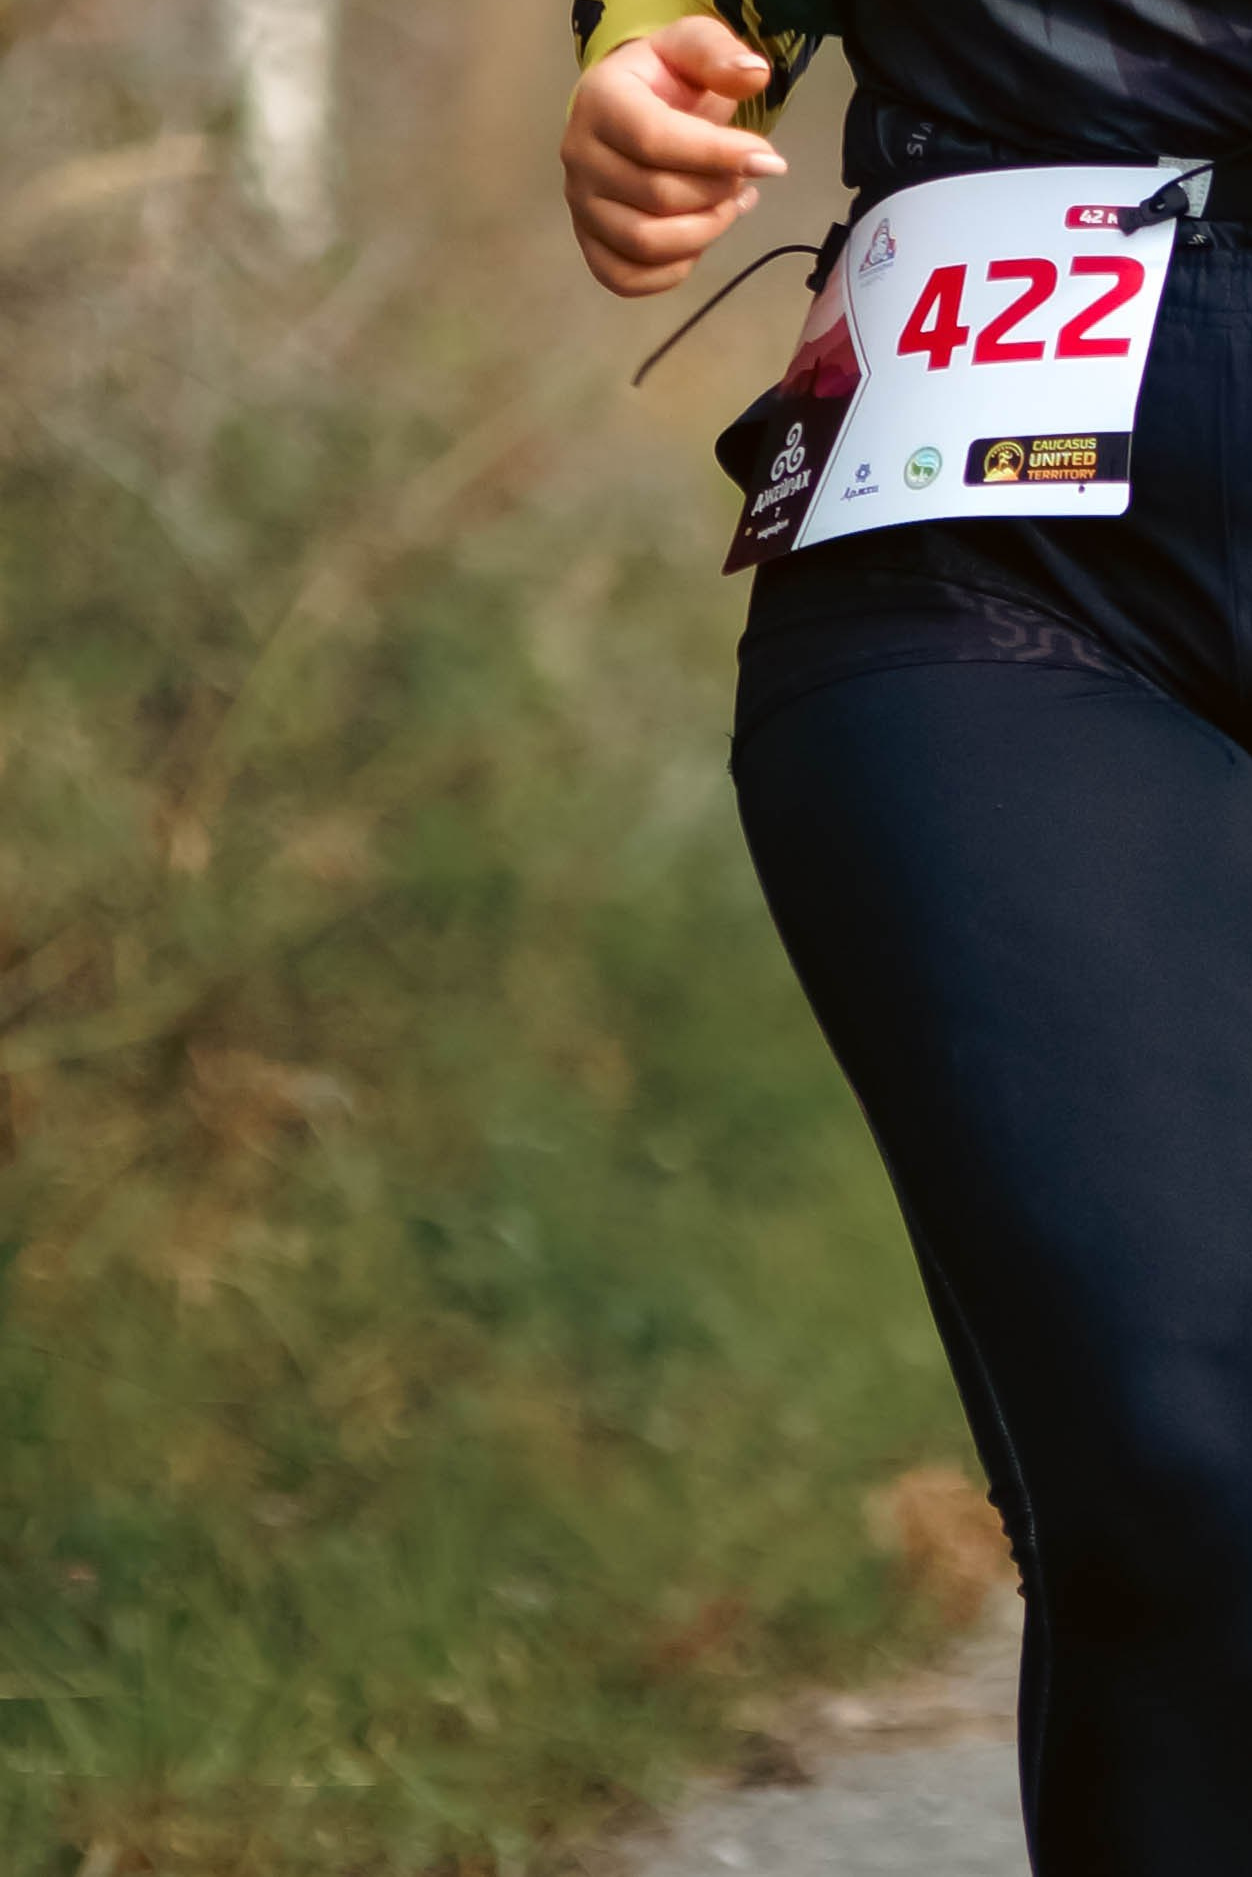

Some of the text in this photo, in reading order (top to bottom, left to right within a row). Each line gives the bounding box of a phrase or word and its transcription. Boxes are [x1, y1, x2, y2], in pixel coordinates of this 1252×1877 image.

[1079, 209, 1105, 225] 42
[896, 255, 1146, 372] 422
[1031, 437, 1097, 452] CAUCASUS
[1028, 451, 1097, 468] UNITED
[1026, 468, 1097, 481] TERRITORY
